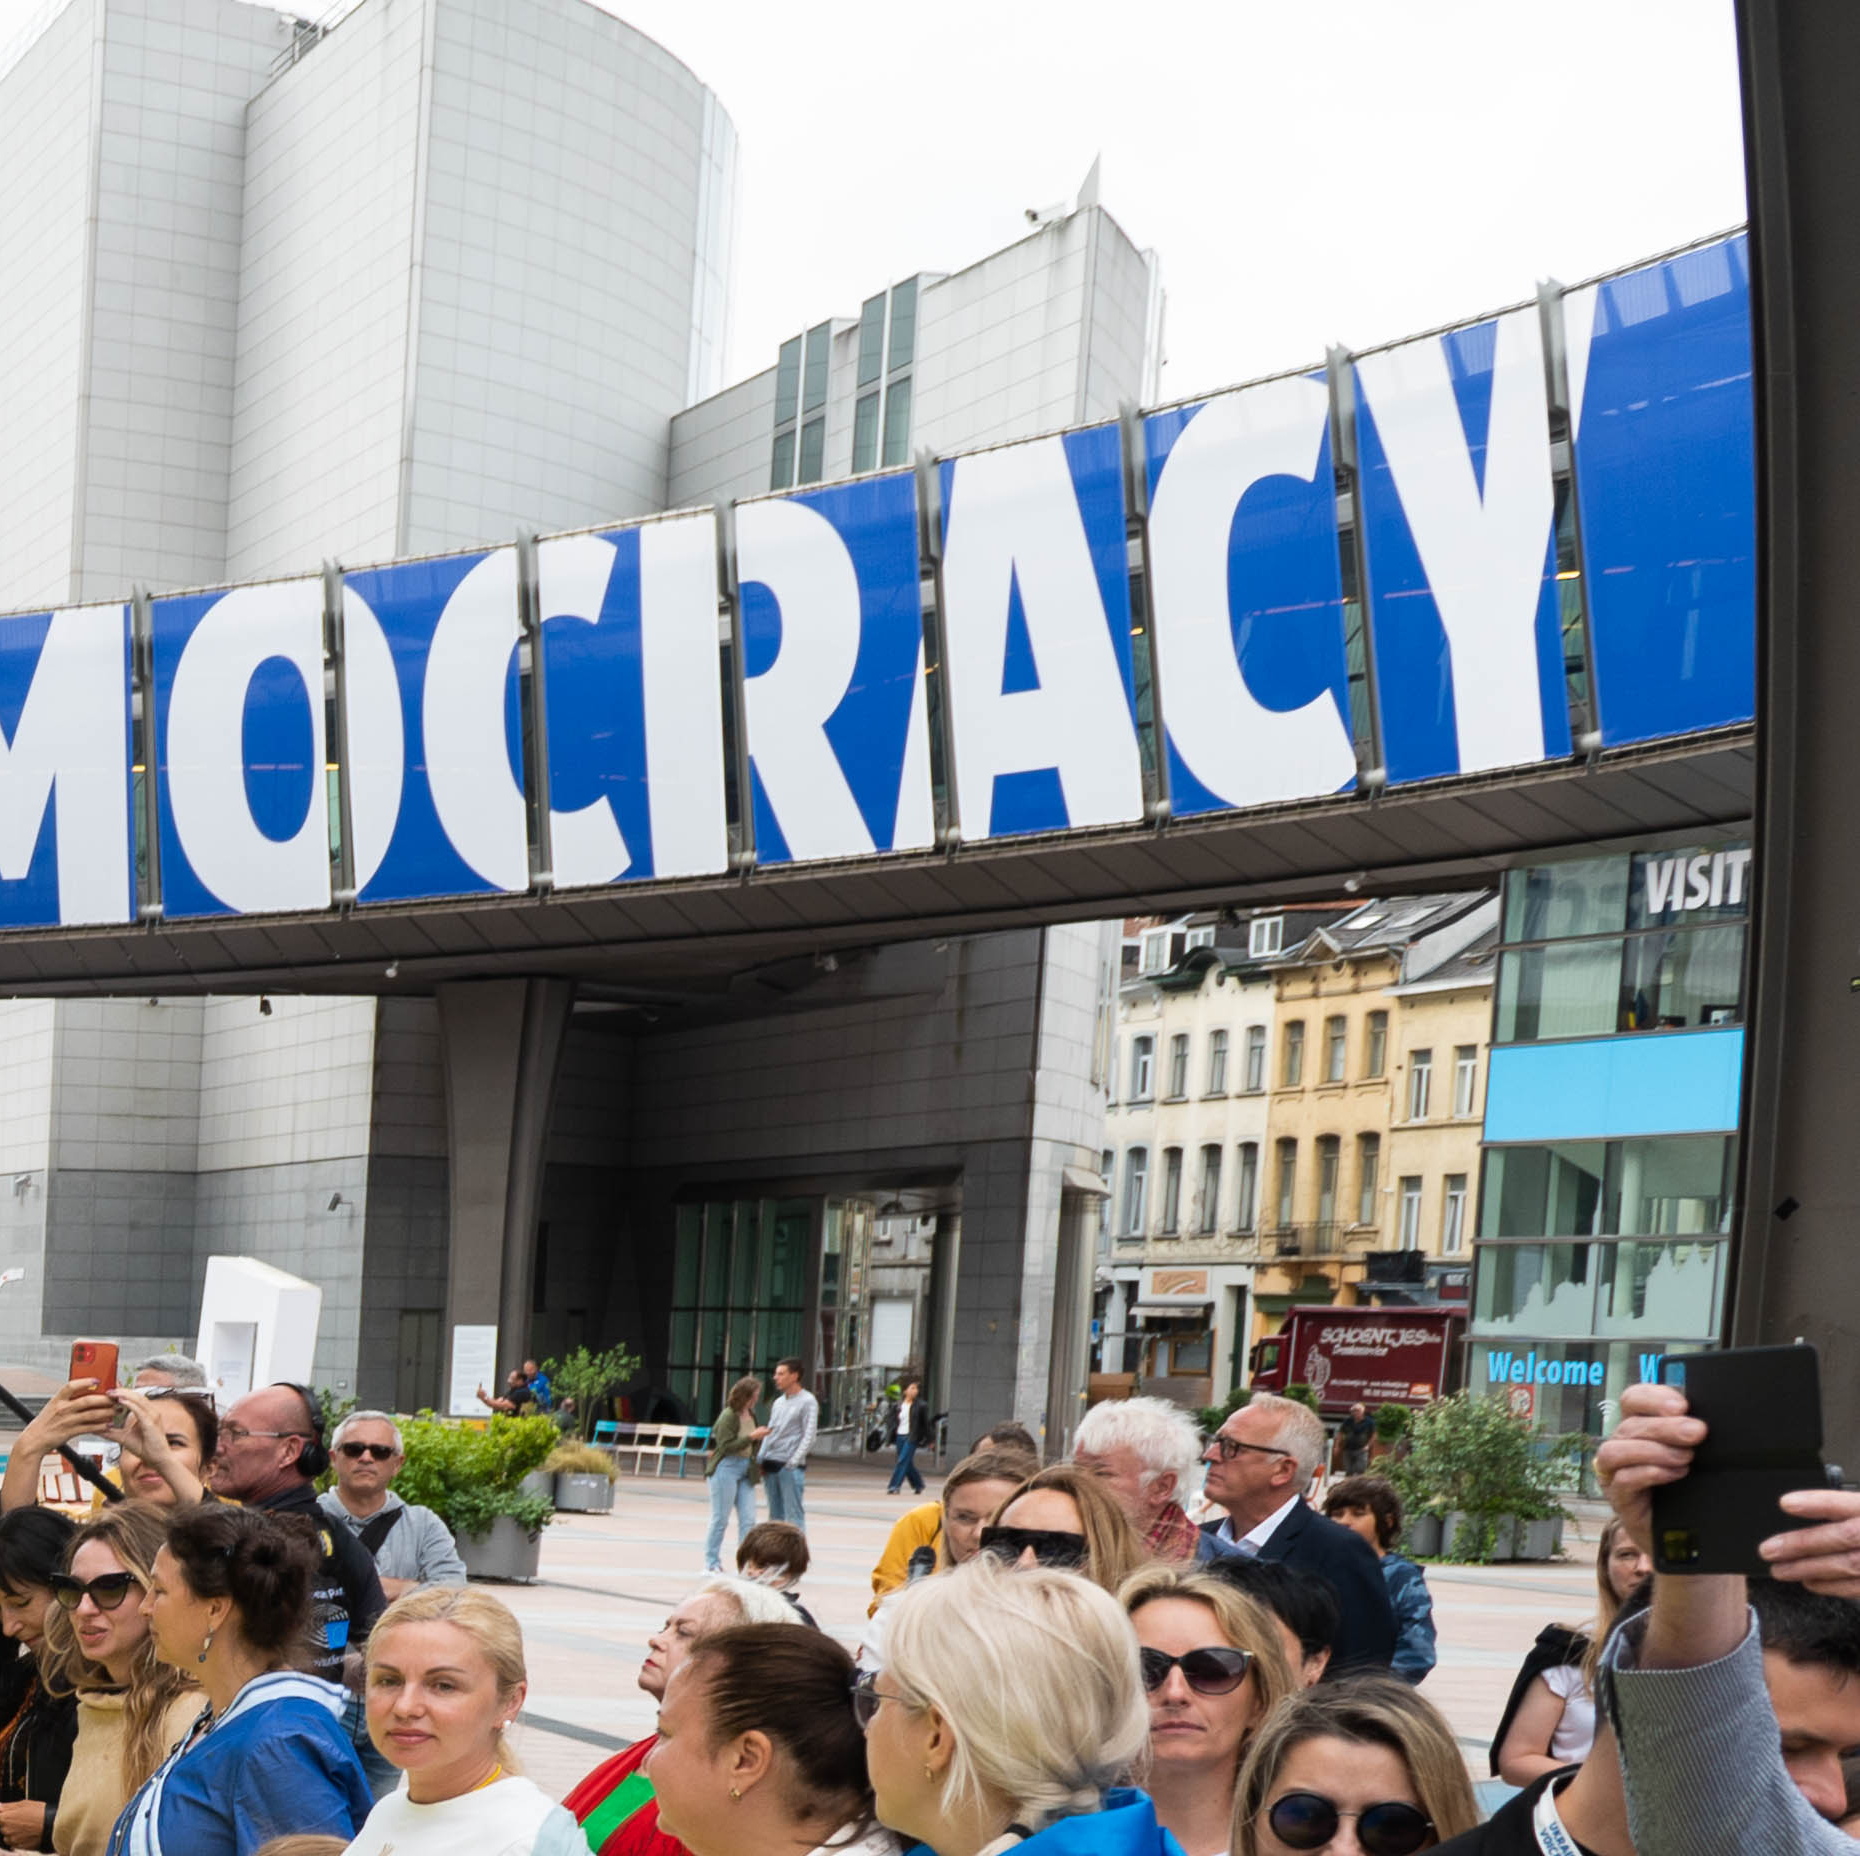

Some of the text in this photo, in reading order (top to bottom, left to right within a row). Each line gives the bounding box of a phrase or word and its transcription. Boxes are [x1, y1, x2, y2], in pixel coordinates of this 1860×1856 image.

[1646, 848, 1753, 914] VISIT
[1319, 1327, 1428, 1348] SCHOENTJES
[1487, 1351, 1605, 1386] Welcome
